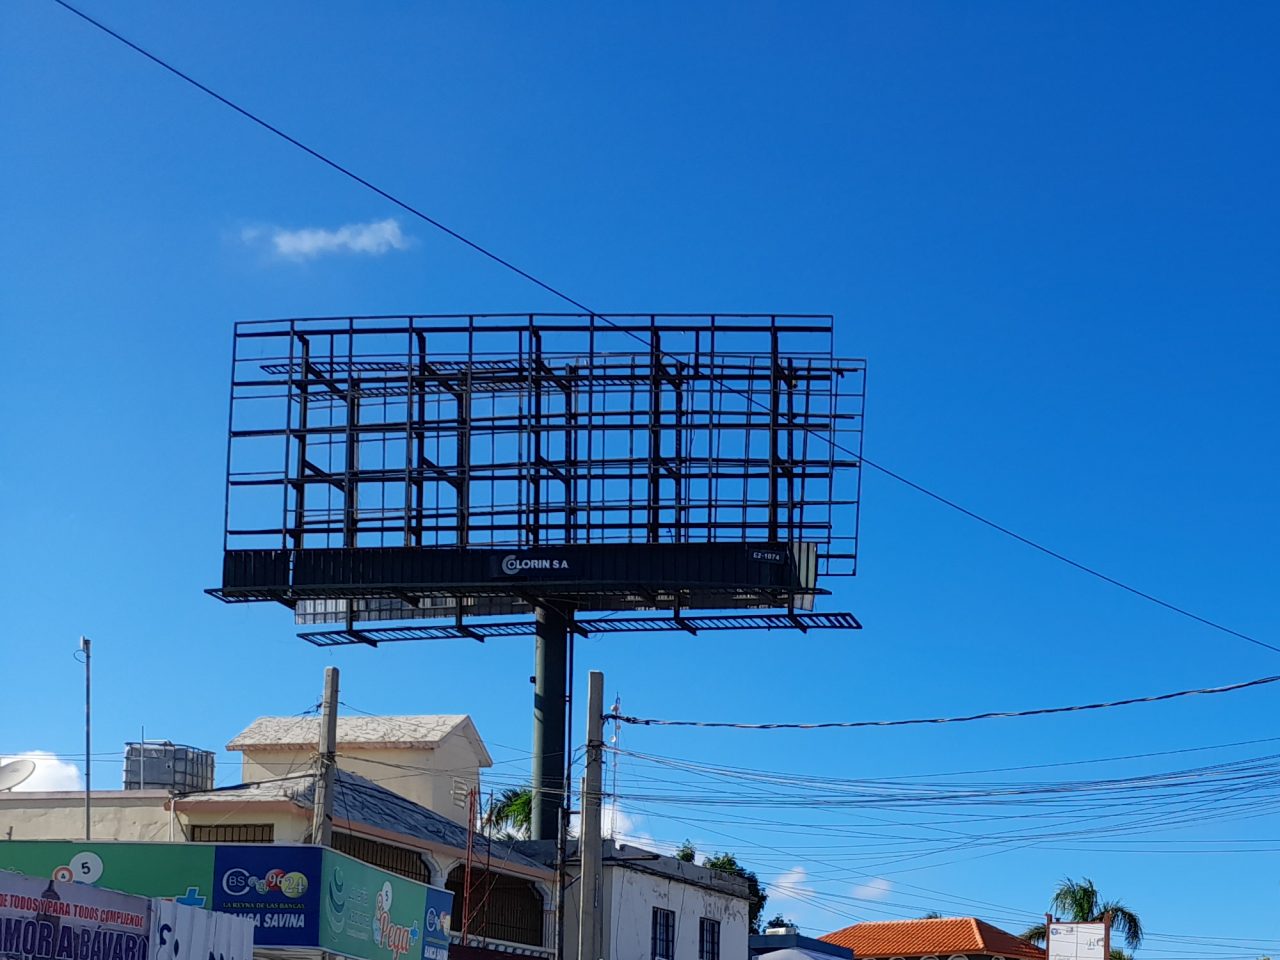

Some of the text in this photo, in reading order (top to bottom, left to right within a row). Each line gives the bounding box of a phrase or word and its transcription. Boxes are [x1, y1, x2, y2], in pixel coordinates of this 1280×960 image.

[10, 895, 38, 911] TODOS
[48, 900, 71, 917] PARA
[73, 904, 99, 920] TODOS
[263, 913, 305, 928] SAVINA
[56, 925, 74, 960] A
